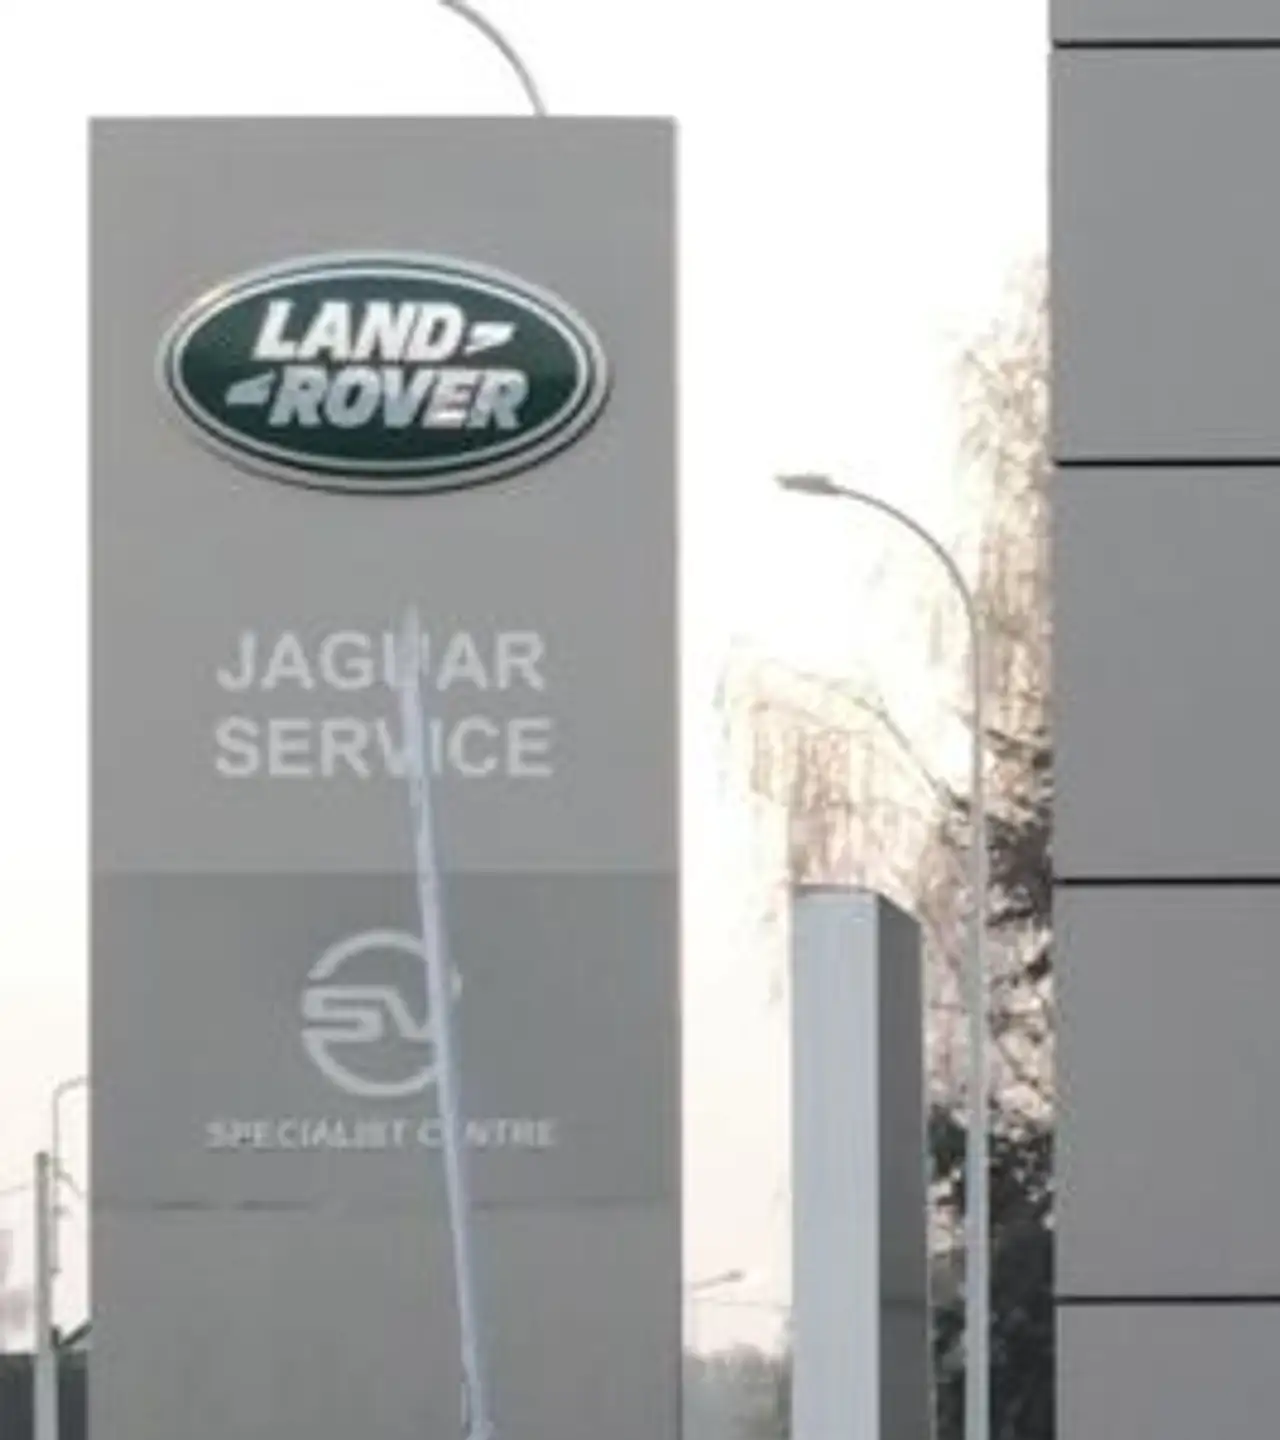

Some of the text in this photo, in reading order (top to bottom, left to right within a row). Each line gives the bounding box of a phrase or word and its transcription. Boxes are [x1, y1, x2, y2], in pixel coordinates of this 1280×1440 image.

[253, 300, 466, 361] LAND
[268, 365, 529, 429] ROVER
[416, 1118, 558, 1148] CNTRE
